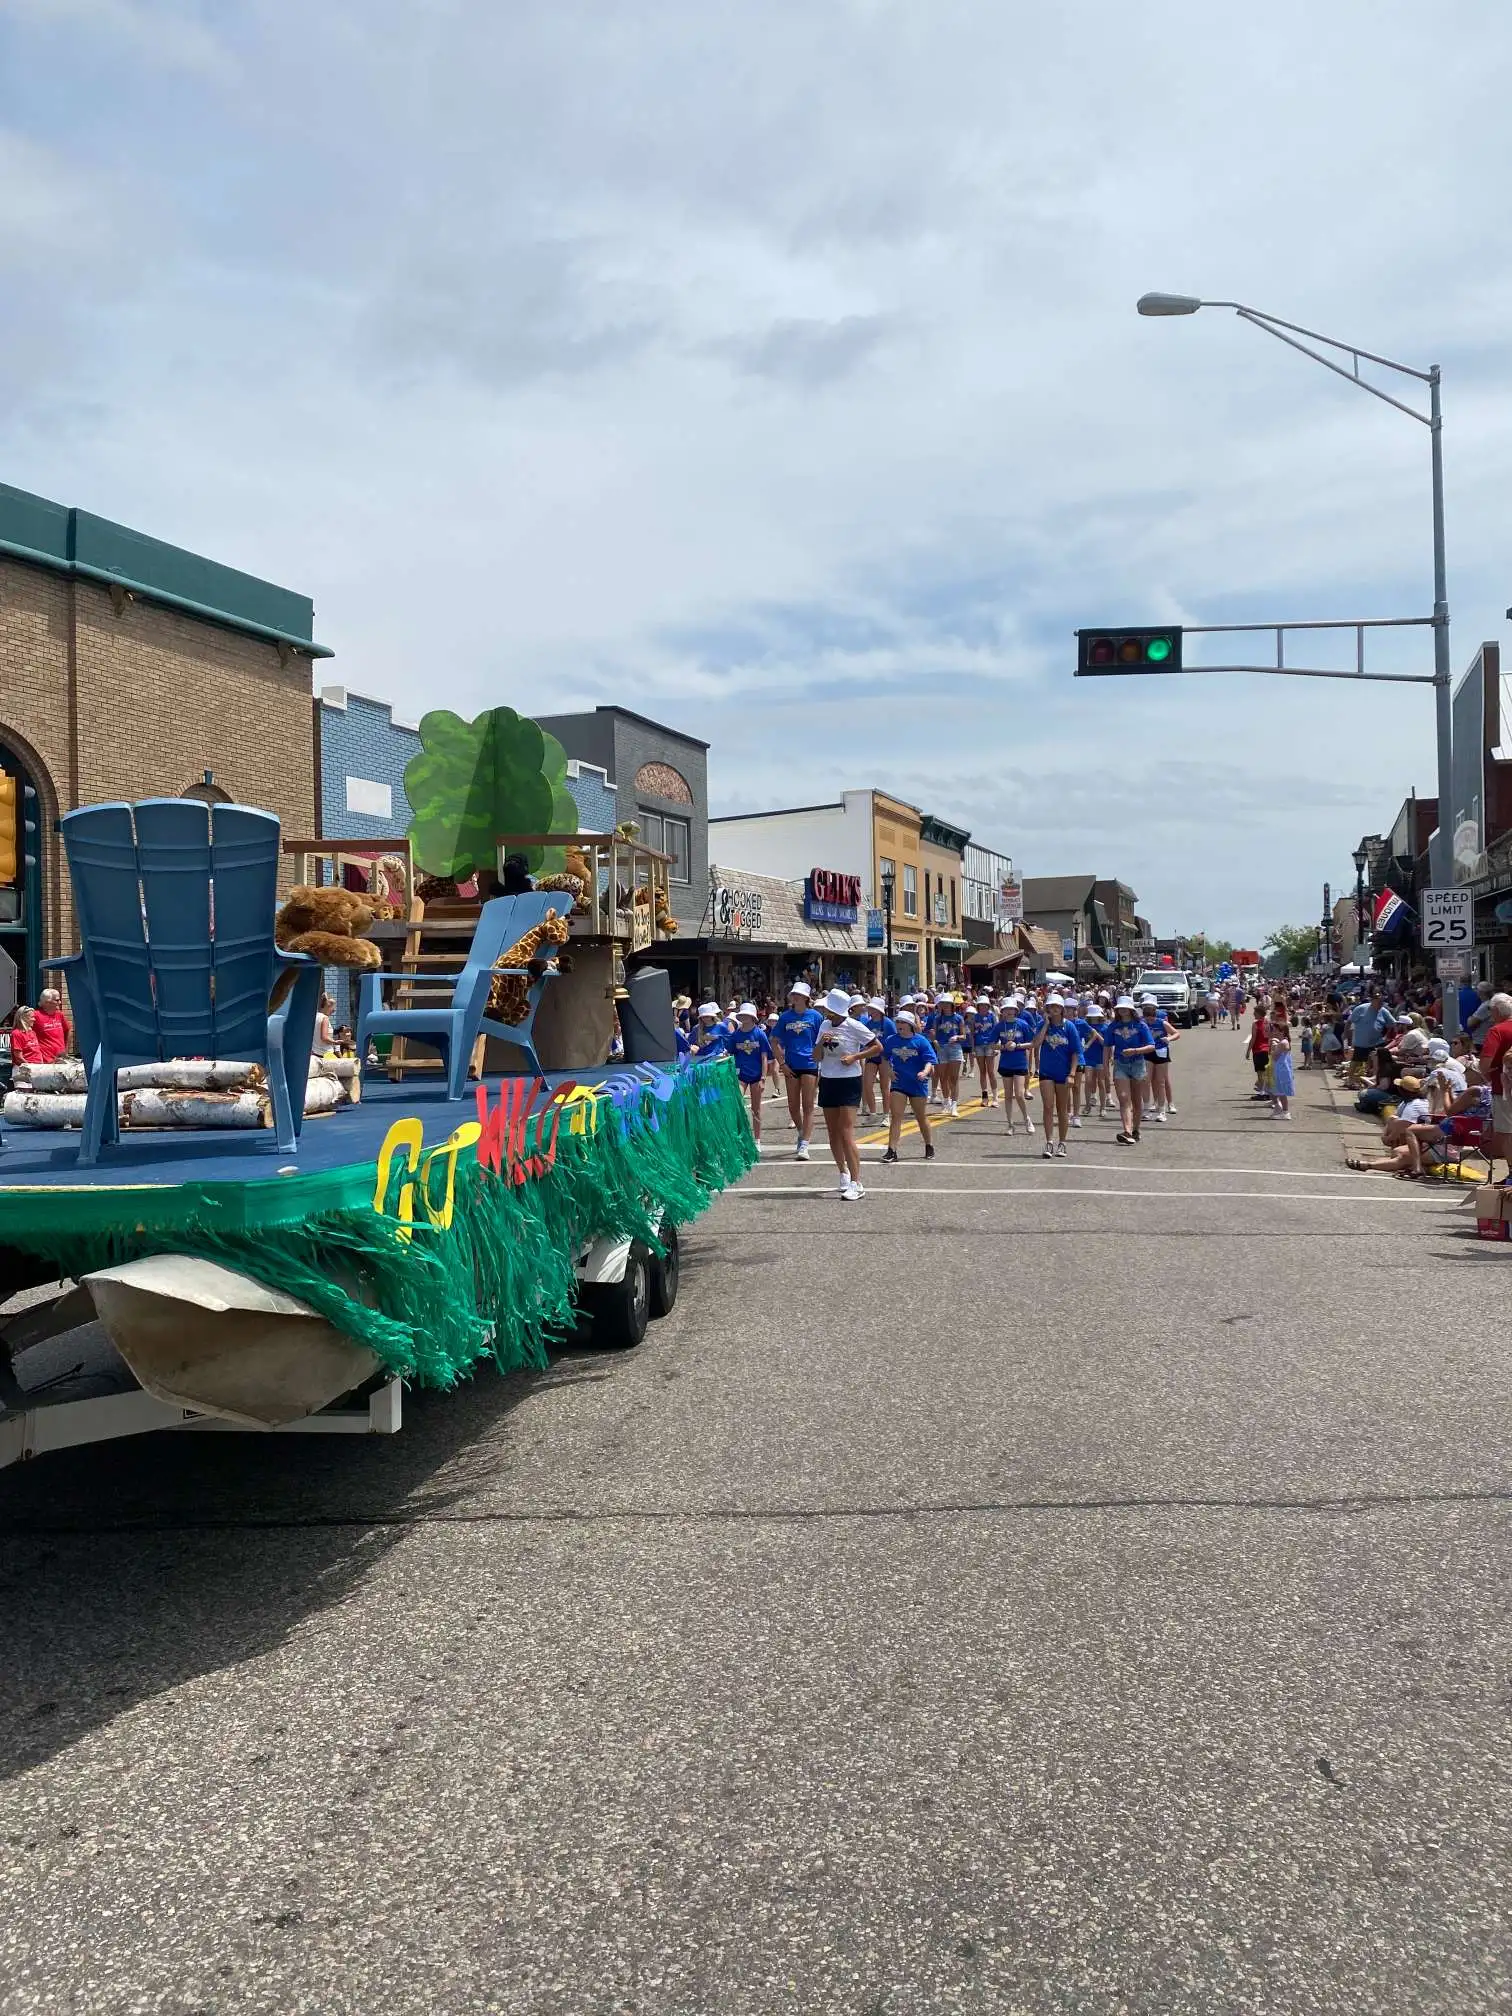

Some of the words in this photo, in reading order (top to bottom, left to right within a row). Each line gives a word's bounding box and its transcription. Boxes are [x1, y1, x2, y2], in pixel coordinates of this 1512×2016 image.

[728, 888, 762, 911] HOOKED
[1426, 892, 1469, 903] SPEED
[1431, 905, 1464, 916] LIMIT
[1427, 920, 1468, 941] 25
